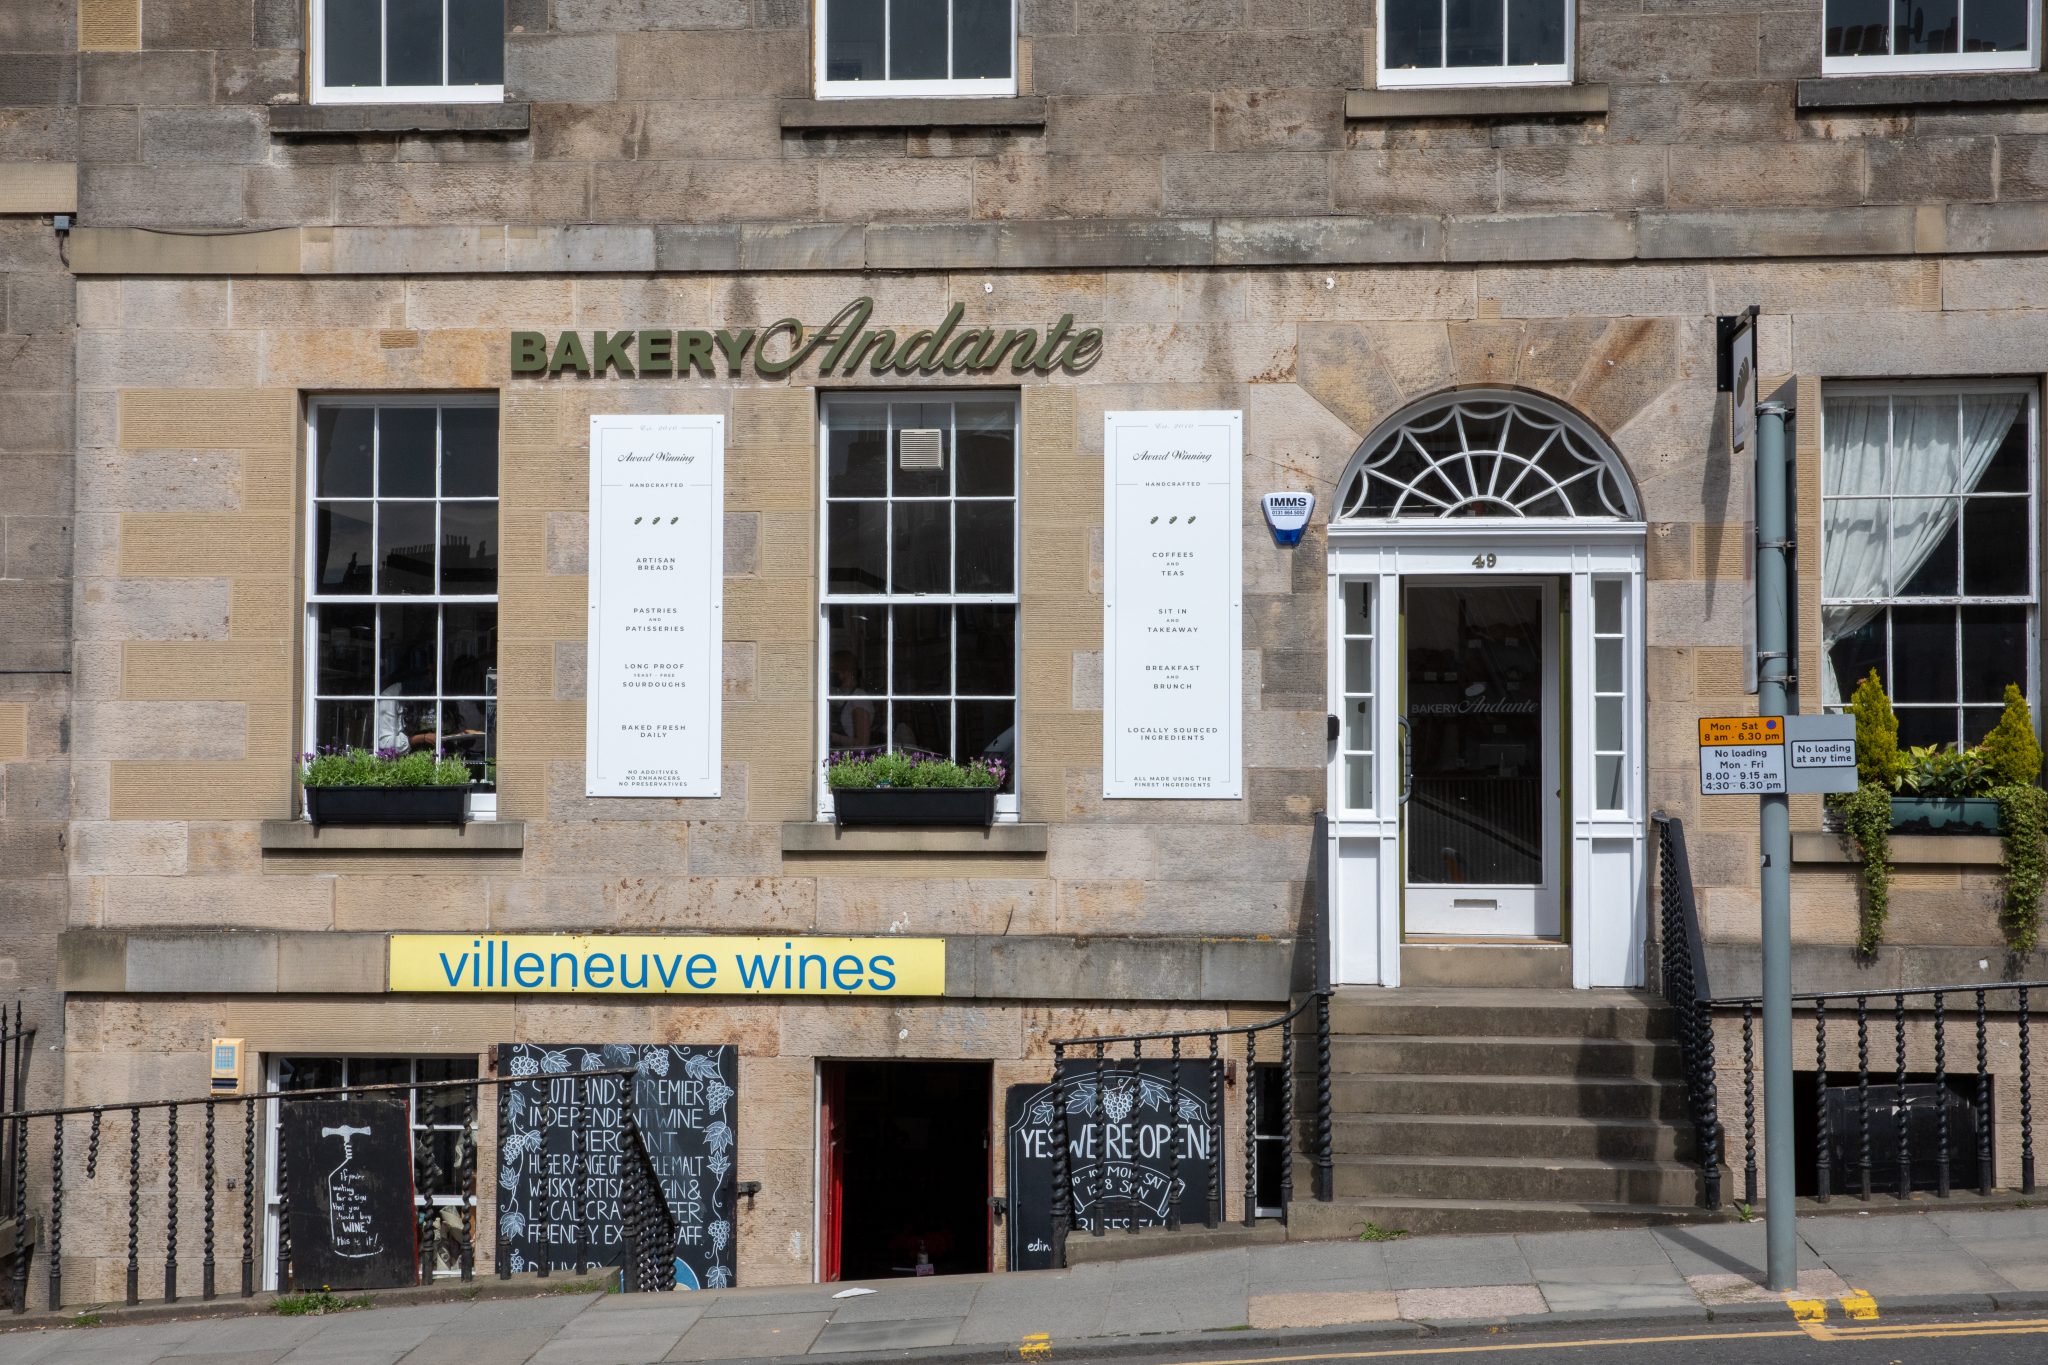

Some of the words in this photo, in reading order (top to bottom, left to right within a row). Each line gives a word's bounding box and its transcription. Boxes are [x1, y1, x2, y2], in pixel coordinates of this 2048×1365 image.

[510, 330, 756, 374] BAKERY
[755, 295, 1105, 374] Andante
[617, 451, 653, 462] Award
[655, 451, 695, 464] Winning
[1132, 450, 1170, 461] Award
[1171, 450, 1212, 463] Winning
[1270, 497, 1307, 507] IMMS
[1472, 553, 1497, 569] 49
[1411, 703, 1458, 714] BAKERY
[1457, 695, 1538, 714] Andante
[1710, 722, 1731, 731] Mon
[1741, 722, 1759, 730] Sat
[1704, 733, 1711, 742] 8
[1738, 732, 1762, 741] 6.30
[1765, 733, 1780, 742] pm
[1715, 750, 1730, 758] No
[1732, 749, 1767, 759] loading
[1797, 745, 1812, 753] No
[1814, 744, 1851, 754] loading
[1720, 761, 1741, 769] Mon
[1751, 761, 1764, 769] Fri
[1796, 755, 1807, 763] at
[1809, 756, 1827, 764] any
[1830, 754, 1852, 763] time
[1706, 772, 1730, 781] 8.00
[1740, 772, 1760, 780] 9.15
[1705, 782, 1730, 791] 4.30
[1740, 781, 1763, 790] 6.30
[1766, 782, 1782, 791] pm
[438, 940, 718, 989] villeneuve
[735, 942, 897, 991] wines
[531, 1078, 626, 1105] SOTLAND'S
[635, 1080, 705, 1106] PREMIER
[655, 1108, 705, 1129] WINE
[571, 1130, 678, 1153] MERCANT
[1021, 1128, 1054, 1159] YES
[1069, 1123, 1134, 1159] WERE
[609, 1154, 623, 1175] OF
[671, 1156, 704, 1177] MALT
[660, 1179, 686, 1199] GIN
[687, 1179, 703, 1200] &
[336, 1192, 346, 1202] for
[332, 1202, 345, 1211] that
[349, 1206, 360, 1214] you
[528, 1199, 580, 1222] LCAL
[585, 1200, 623, 1221] CRA
[342, 1221, 368, 1234] WINE,
[336, 1236, 351, 1247] this
